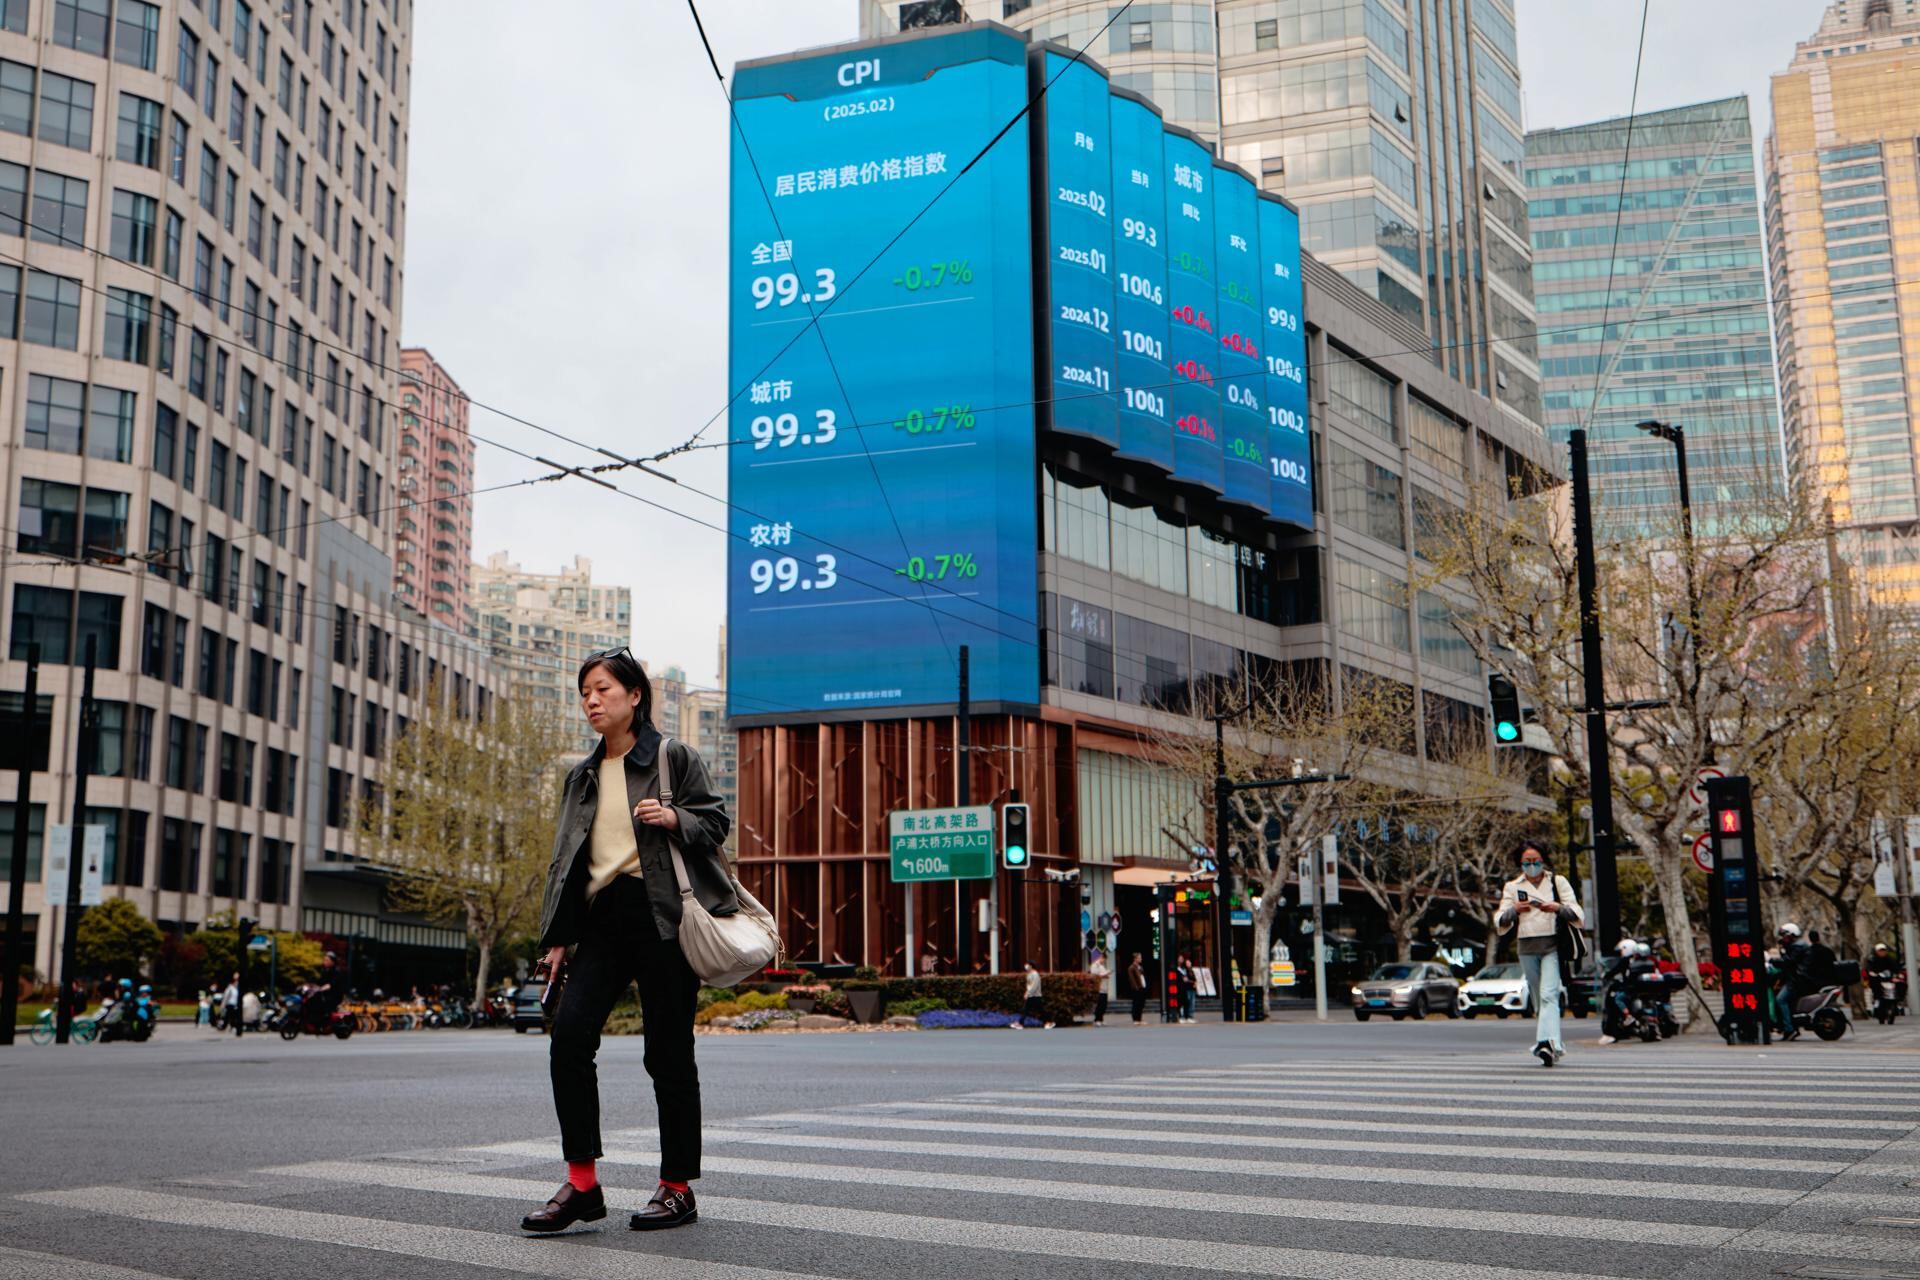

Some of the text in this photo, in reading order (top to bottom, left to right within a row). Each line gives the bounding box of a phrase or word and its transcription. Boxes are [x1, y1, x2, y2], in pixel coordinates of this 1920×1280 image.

[837, 59, 880, 86] CPI
[824, 97, 895, 121] (2025.02)
[1074, 131, 1094, 152] 月份
[775, 152, 947, 197] 居民消费价格指数
[1131, 169, 1149, 188] 当月
[1173, 163, 1203, 193] 城市
[1183, 203, 1200, 222] 同比
[751, 240, 793, 265] 全国
[1230, 234, 1247, 252] 环比
[1058, 188, 1106, 217] 2025.02
[1123, 218, 1157, 248] 99.3
[1268, 307, 1297, 332] 99.9
[752, 259, 972, 310] 99.3 -0.7%
[1060, 246, 1106, 274] 2025.01
[1120, 273, 1163, 305] 100.6
[1266, 356, 1302, 384] 100.6
[1061, 306, 1109, 334] 2024.12
[1123, 330, 1162, 361] 100.1
[1268, 406, 1304, 434] 100.2
[750, 380, 793, 404] 城市
[751, 405, 975, 450] 99.3 -0.7%
[1062, 366, 1109, 392] 2024.11
[1124, 388, 1164, 418] 100.1
[1271, 457, 1306, 485] 100.2
[750, 522, 793, 547] 农村
[750, 553, 977, 594] 99.3 -0.7%
[903, 813, 979, 831] 南北高架路
[896, 834, 988, 851] 卢浦大桥方向入口
